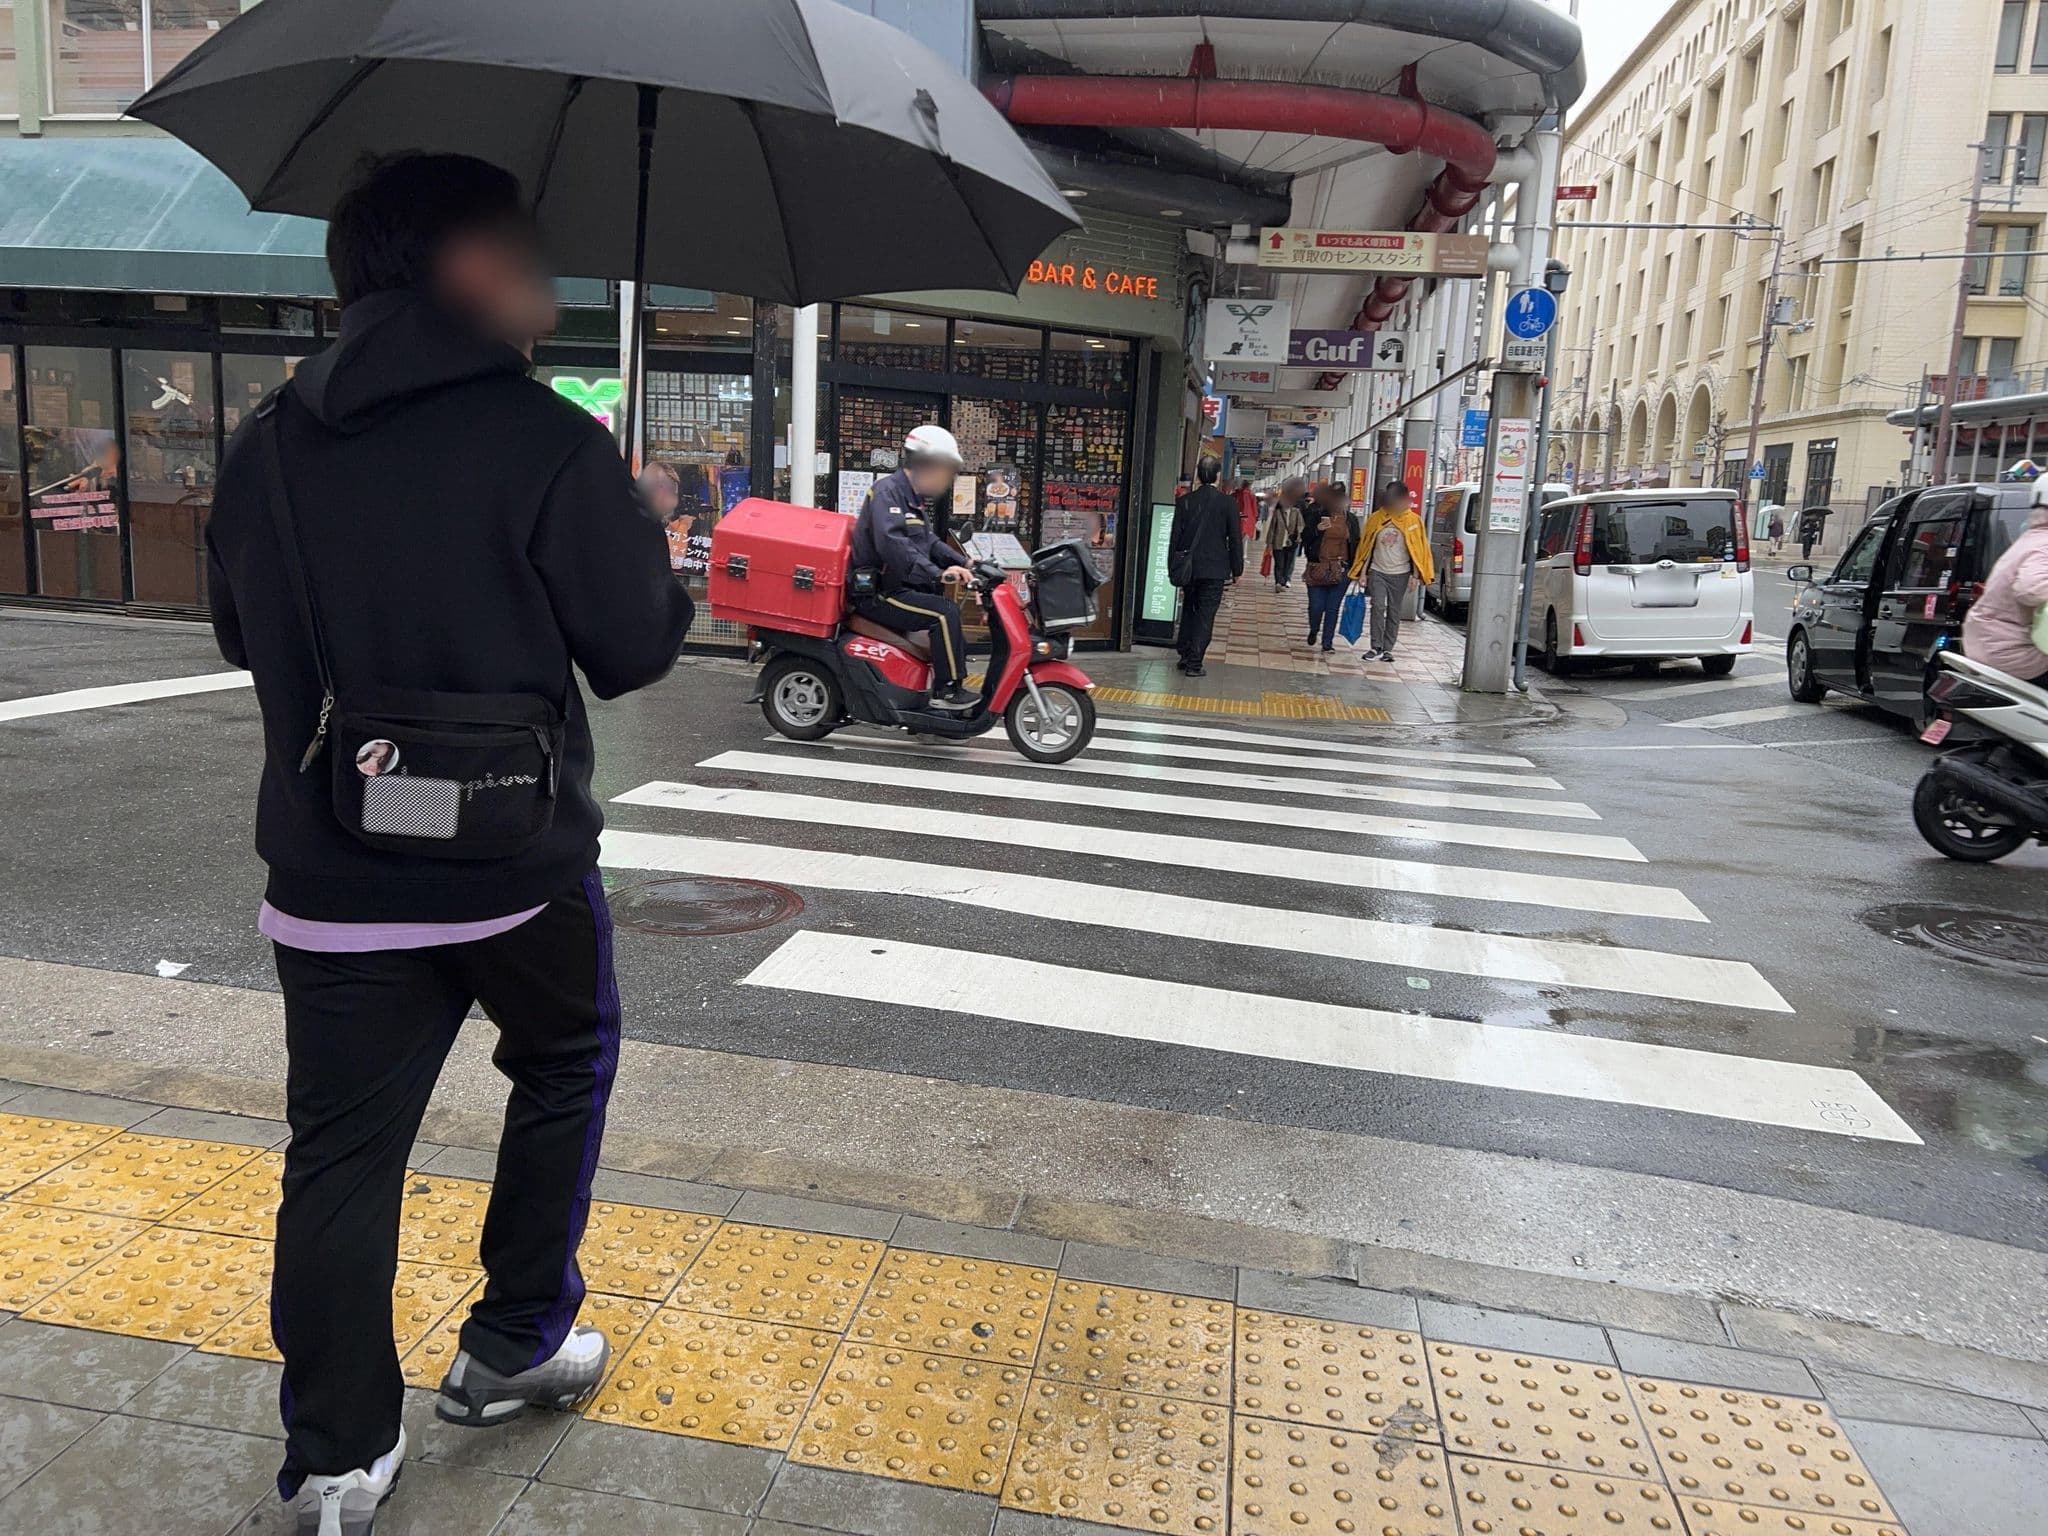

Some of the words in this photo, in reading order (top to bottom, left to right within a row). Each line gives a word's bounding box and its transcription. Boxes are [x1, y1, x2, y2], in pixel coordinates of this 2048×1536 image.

[1292, 248, 1424, 267] 買取のセンススタジオ
[1027, 259, 1075, 287] BAR
[1082, 267, 1097, 289] &
[1105, 271, 1158, 298] CAFE
[1305, 337, 1364, 362] Guf
[1507, 345, 1545, 357] 自転車通行可
[1499, 425, 1530, 433] Shoden
